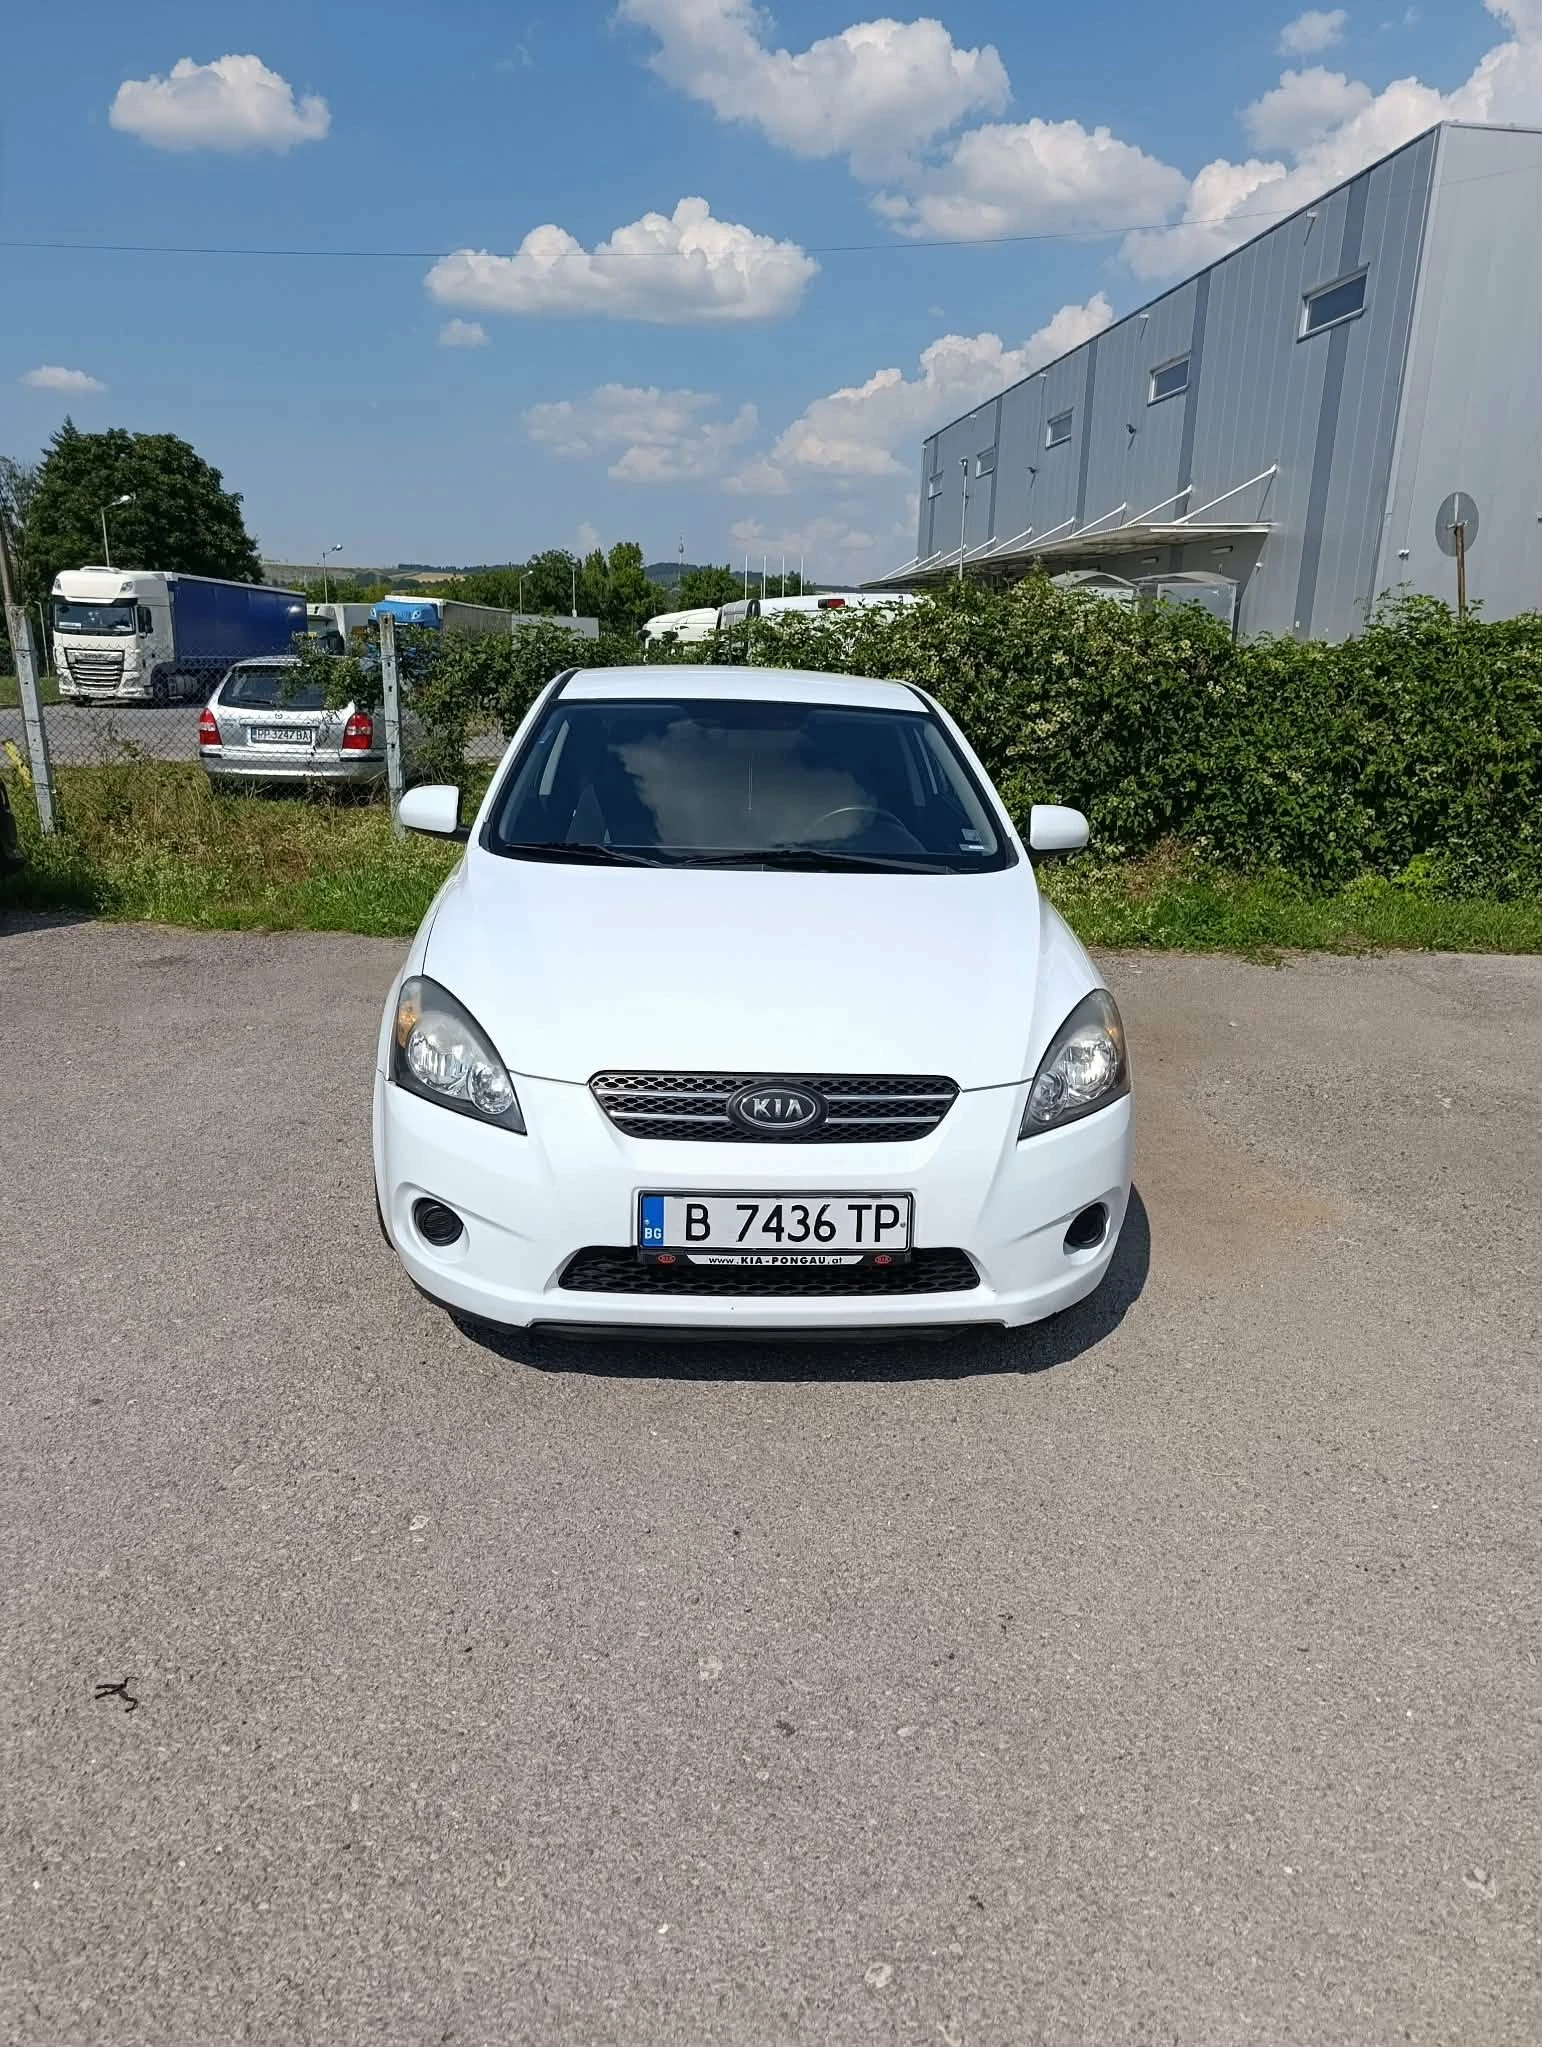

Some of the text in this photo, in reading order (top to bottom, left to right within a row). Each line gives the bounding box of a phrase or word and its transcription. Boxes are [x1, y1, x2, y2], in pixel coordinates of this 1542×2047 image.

[752, 1097, 803, 1118] KIA
[685, 1203, 900, 1243] B 7436 TP
[644, 1227, 662, 1240] BG
[708, 1256, 843, 1265] www.KIA-PONGAU.at
